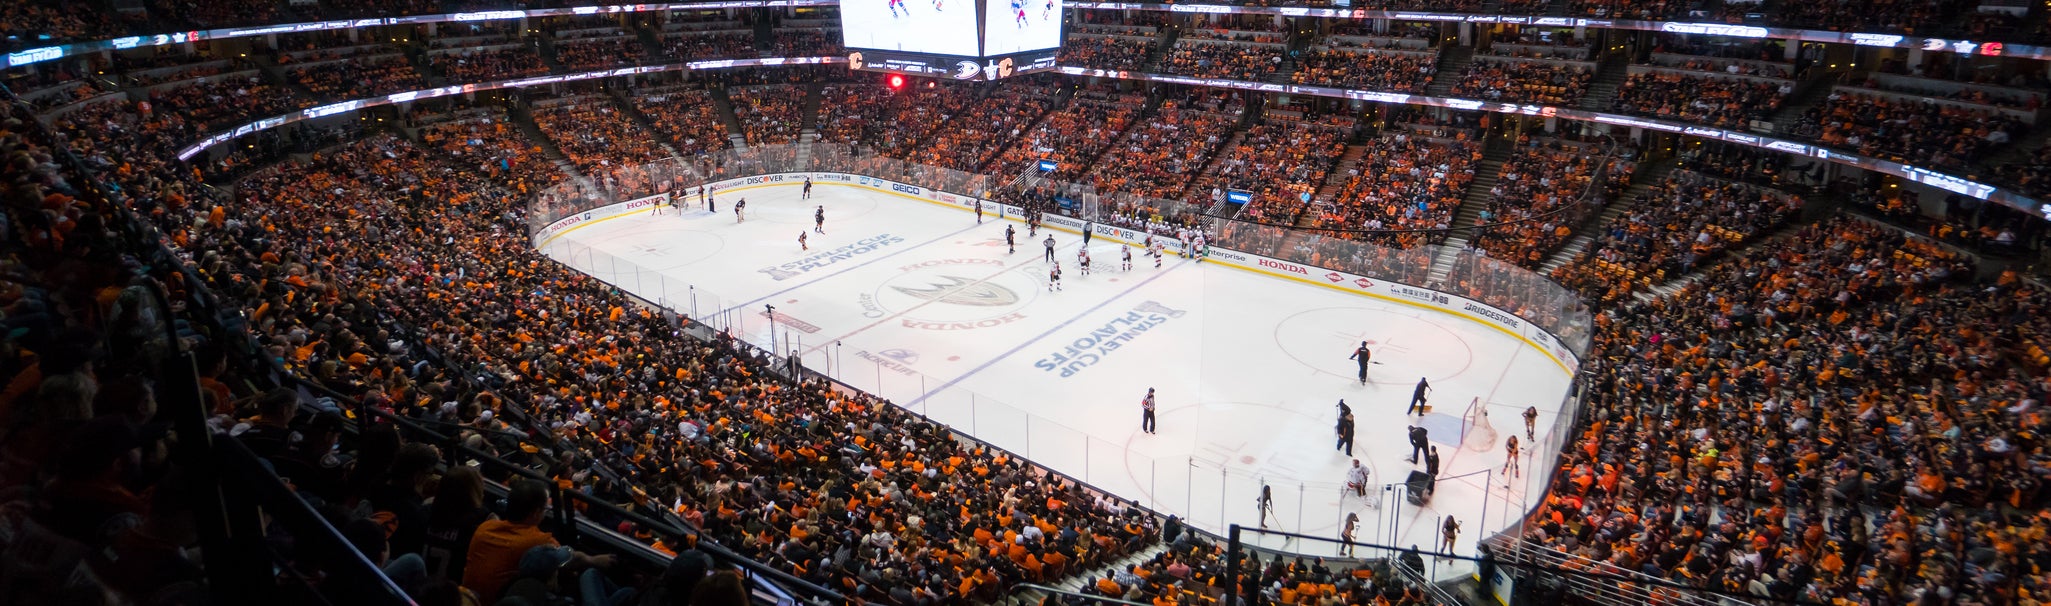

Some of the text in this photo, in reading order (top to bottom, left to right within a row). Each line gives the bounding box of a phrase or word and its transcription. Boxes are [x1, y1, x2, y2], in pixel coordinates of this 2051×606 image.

[747, 175, 783, 184] DISCOVER
[893, 183, 920, 195] GEICO
[626, 196, 666, 209] HONA
[550, 216, 581, 233] HONDA
[1097, 225, 1134, 240] DISCOVER
[781, 233, 891, 270] STANLEY CUP
[800, 236, 905, 272] PLAYOFFS
[901, 258, 1006, 272] HONDA
[1258, 258, 1308, 275] HONDA
[902, 312, 1028, 331] HONDA
[1464, 302, 1519, 329] BRIDGESTONE
[1034, 311, 1144, 372] PLAYOFFS
[1060, 313, 1167, 378] STANLEY CUP
